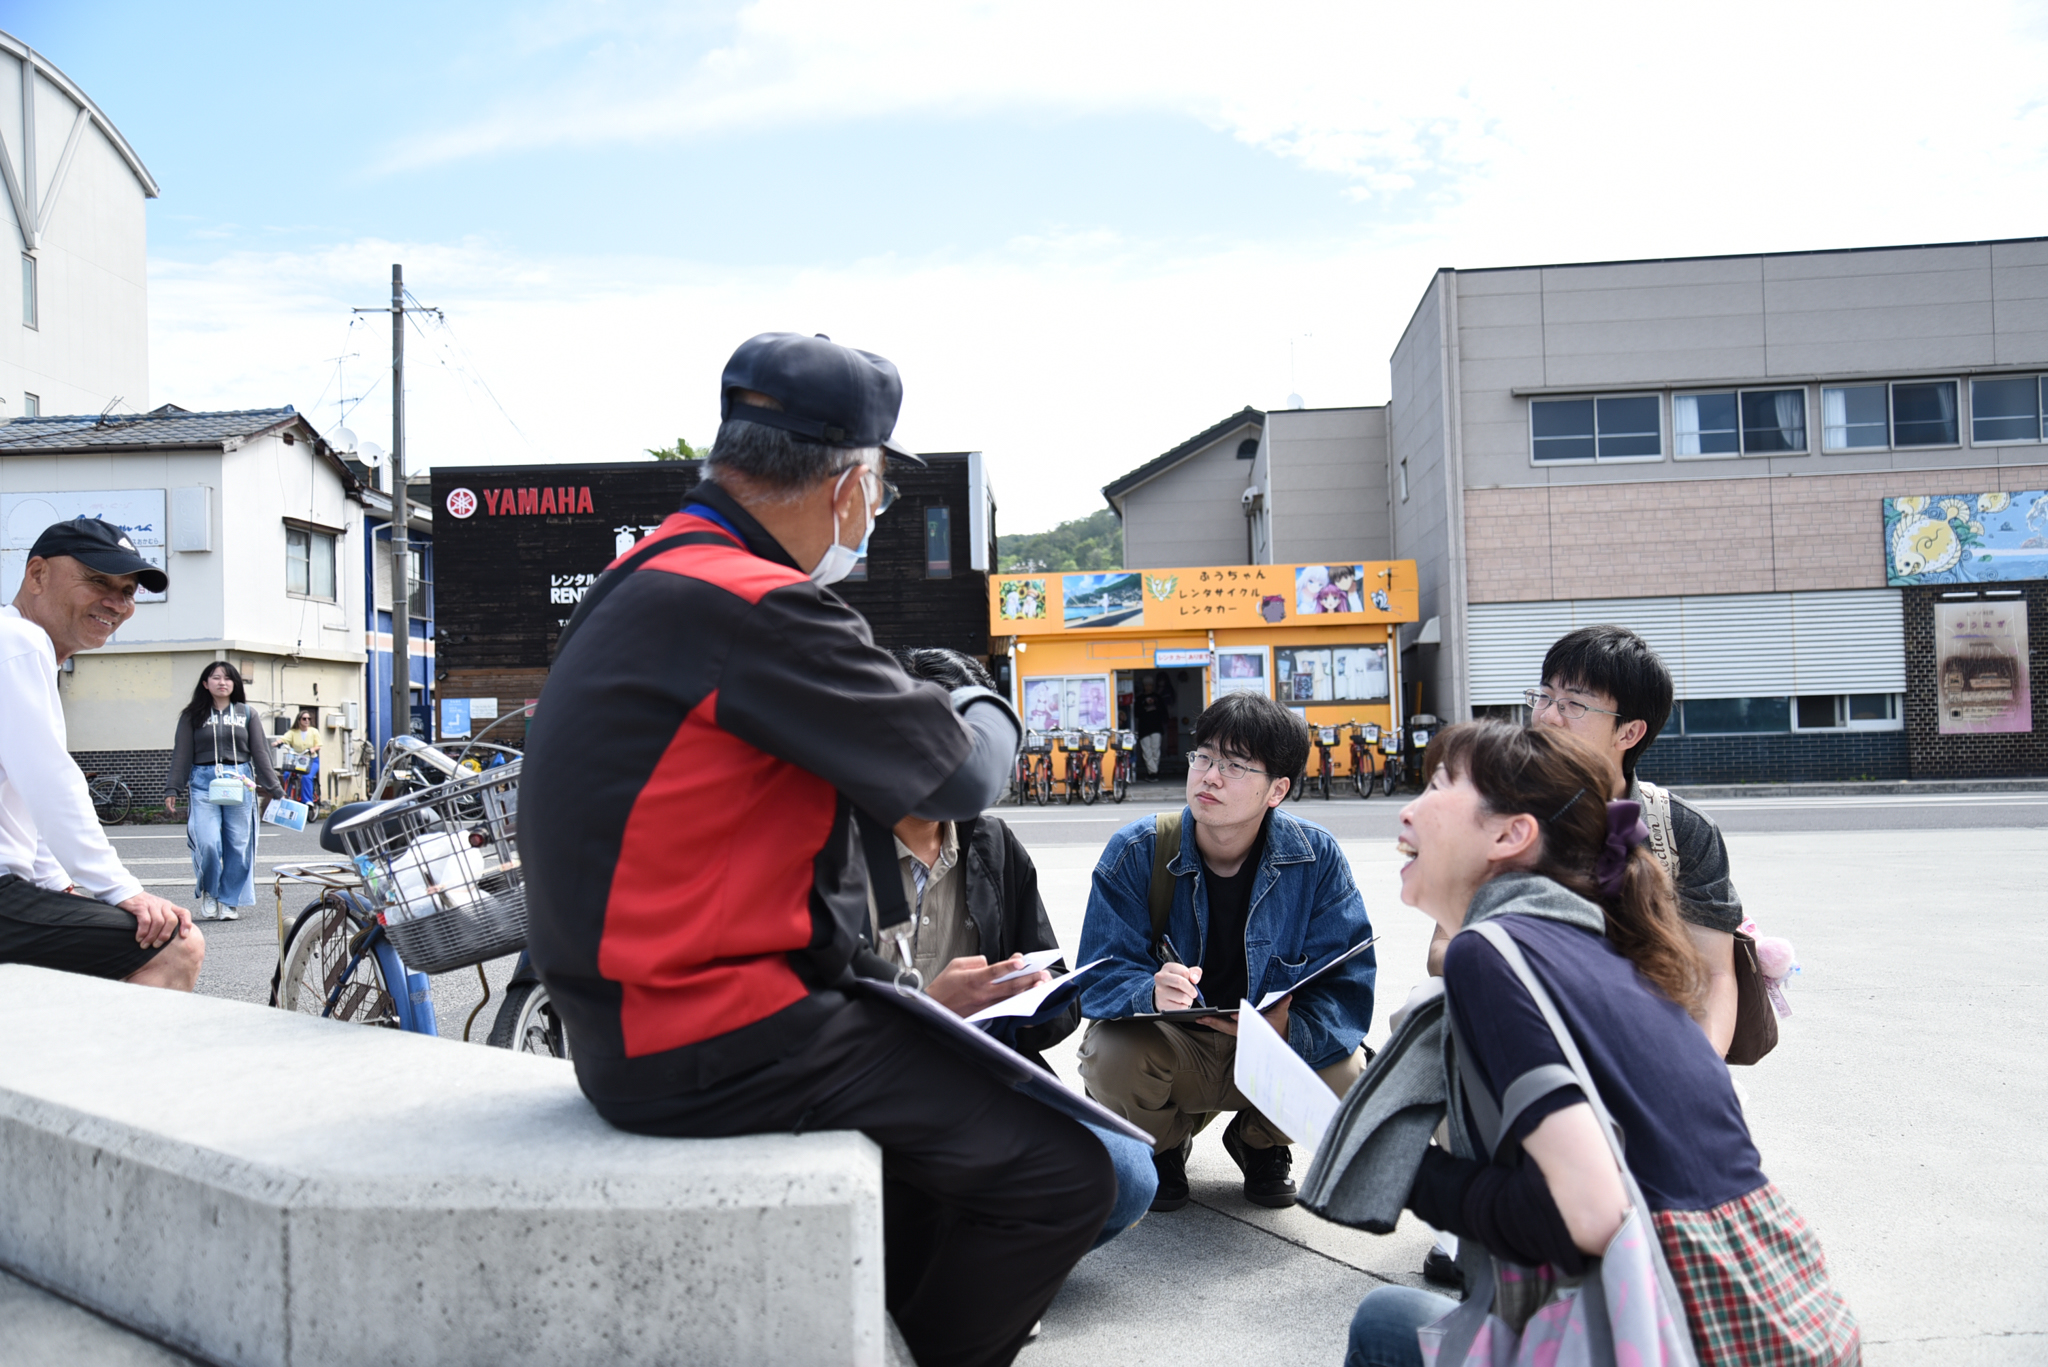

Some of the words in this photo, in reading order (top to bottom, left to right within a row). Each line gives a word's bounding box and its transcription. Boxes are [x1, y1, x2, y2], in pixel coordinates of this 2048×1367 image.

[483, 486, 594, 516] YAMAHA
[551, 573, 602, 587] レンタル
[1200, 570, 1266, 581] ふうちゃん
[1179, 588, 1261, 599] レンタサイクル
[1180, 605, 1237, 615] レンタカー
